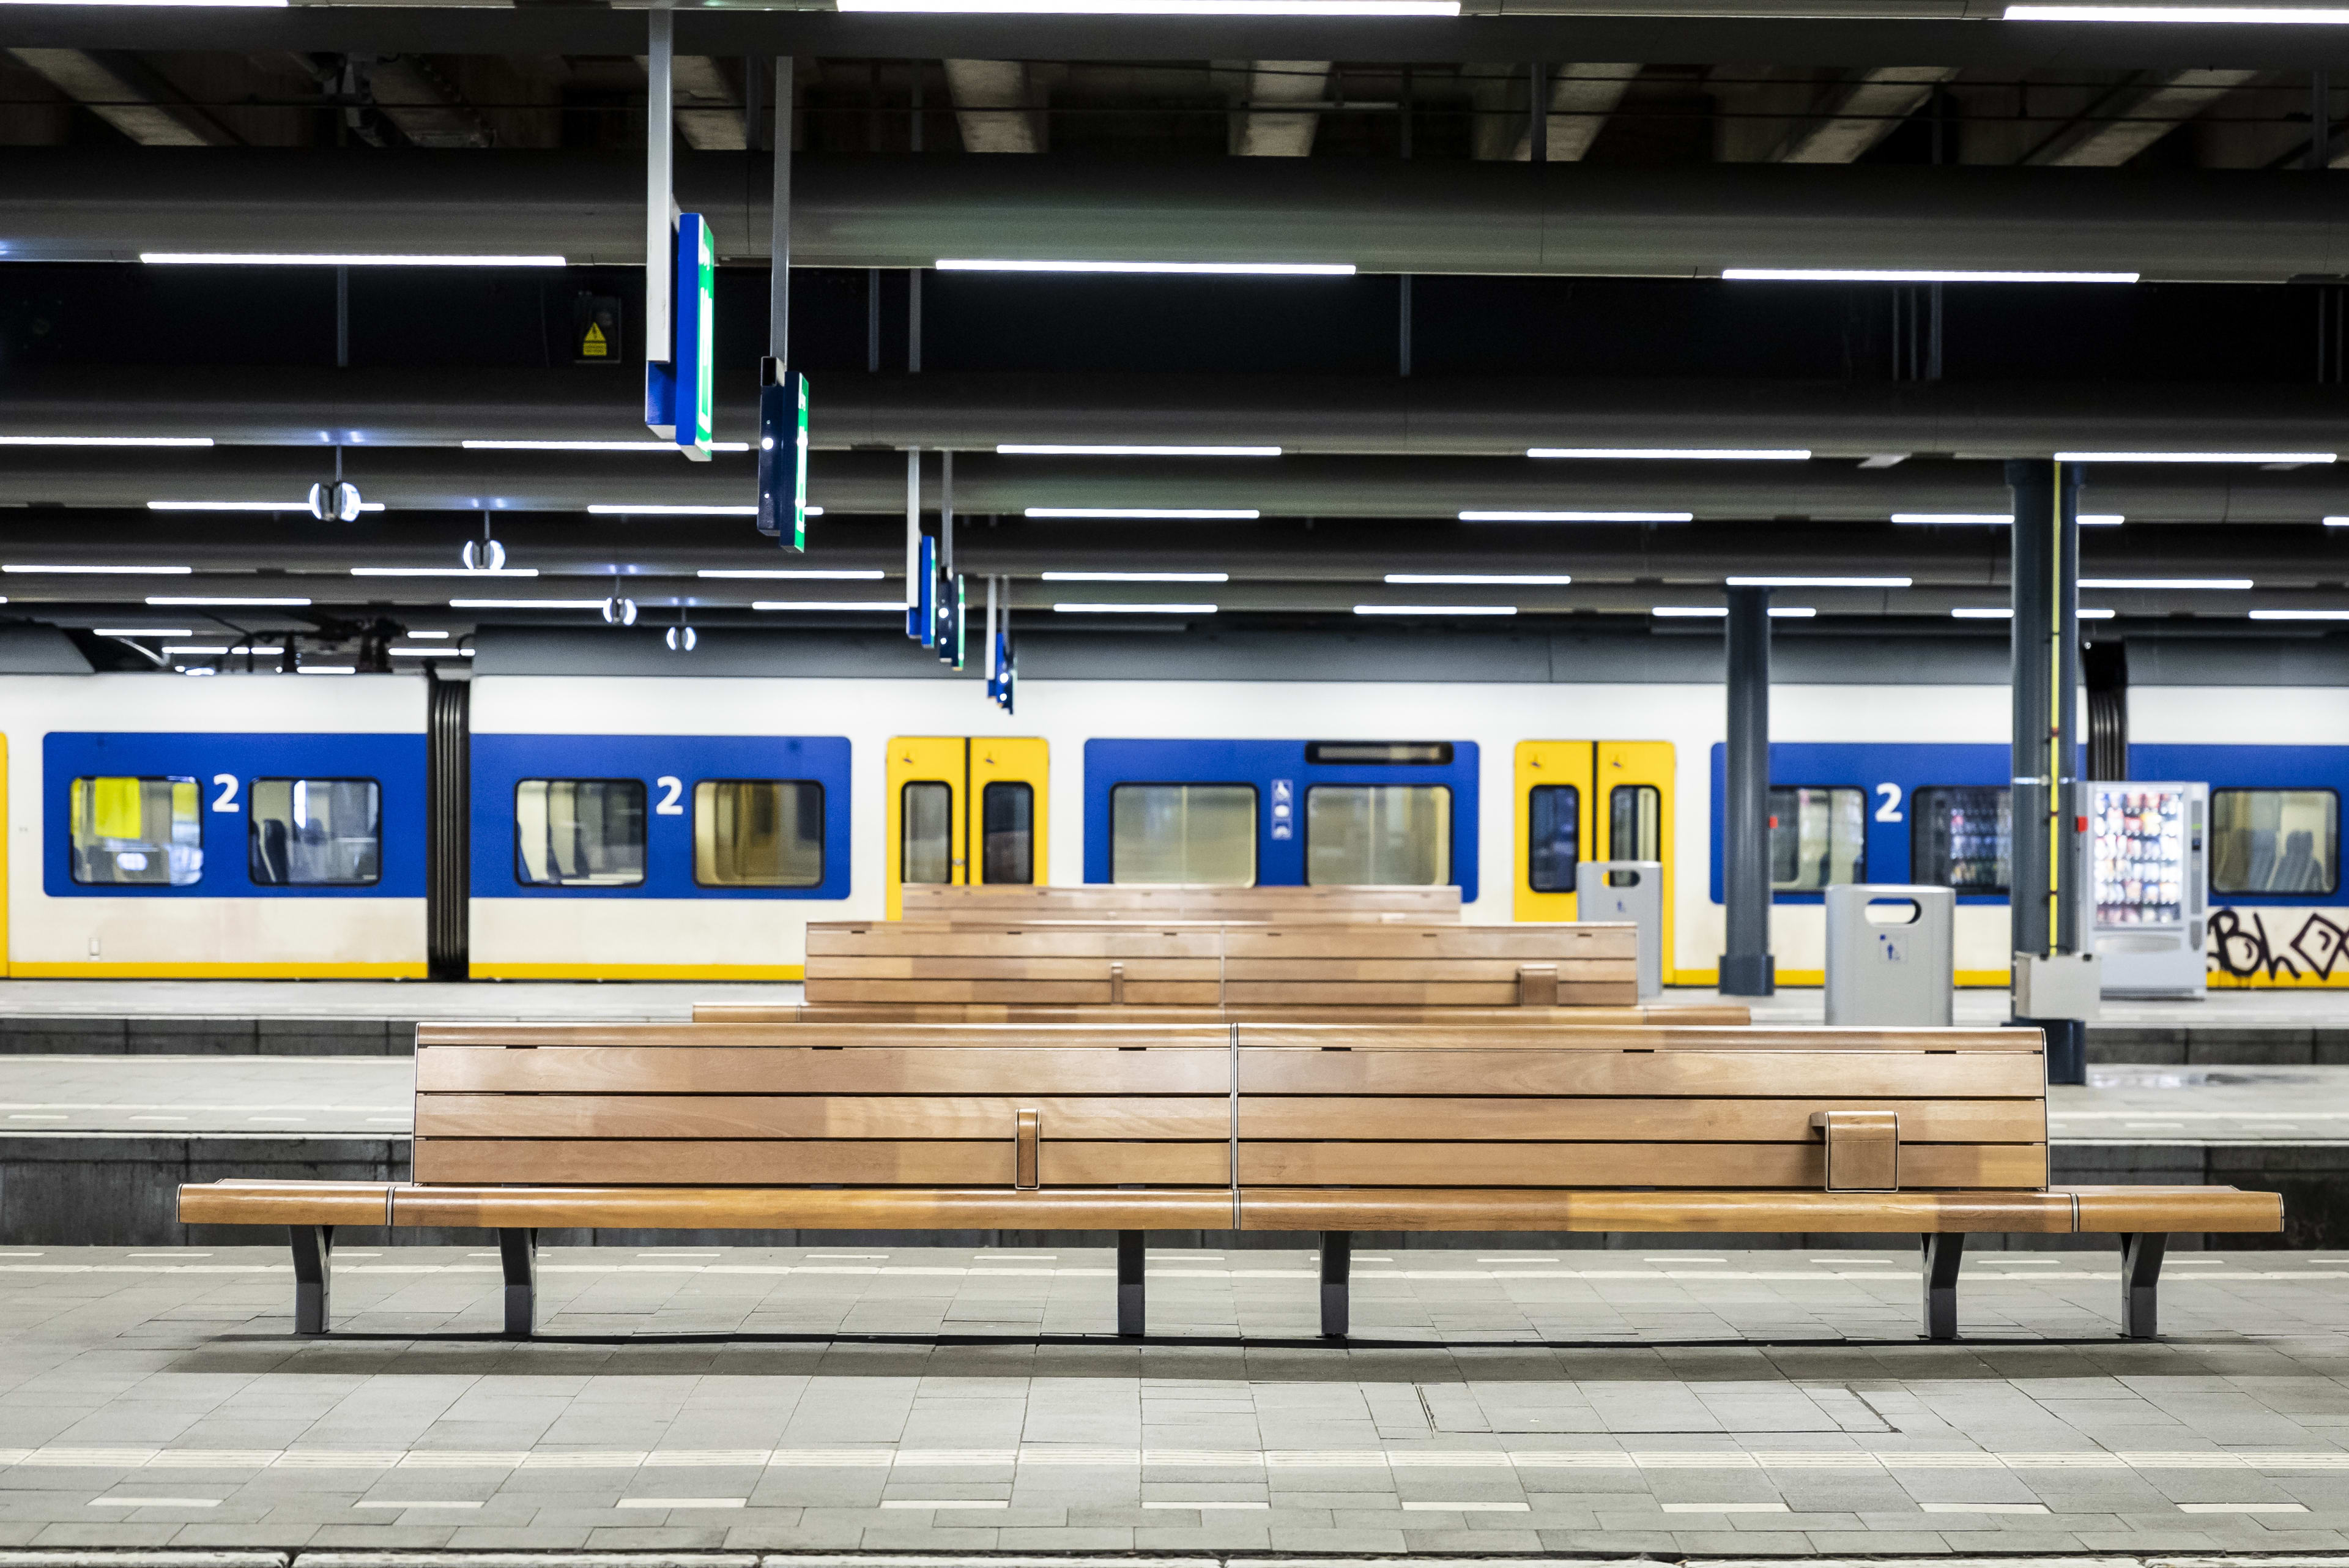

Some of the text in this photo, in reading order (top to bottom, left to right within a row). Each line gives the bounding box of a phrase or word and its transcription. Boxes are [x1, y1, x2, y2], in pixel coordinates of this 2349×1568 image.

[212, 773, 240, 812] 2
[656, 776, 683, 815] 2
[1875, 782, 1902, 822] 2
